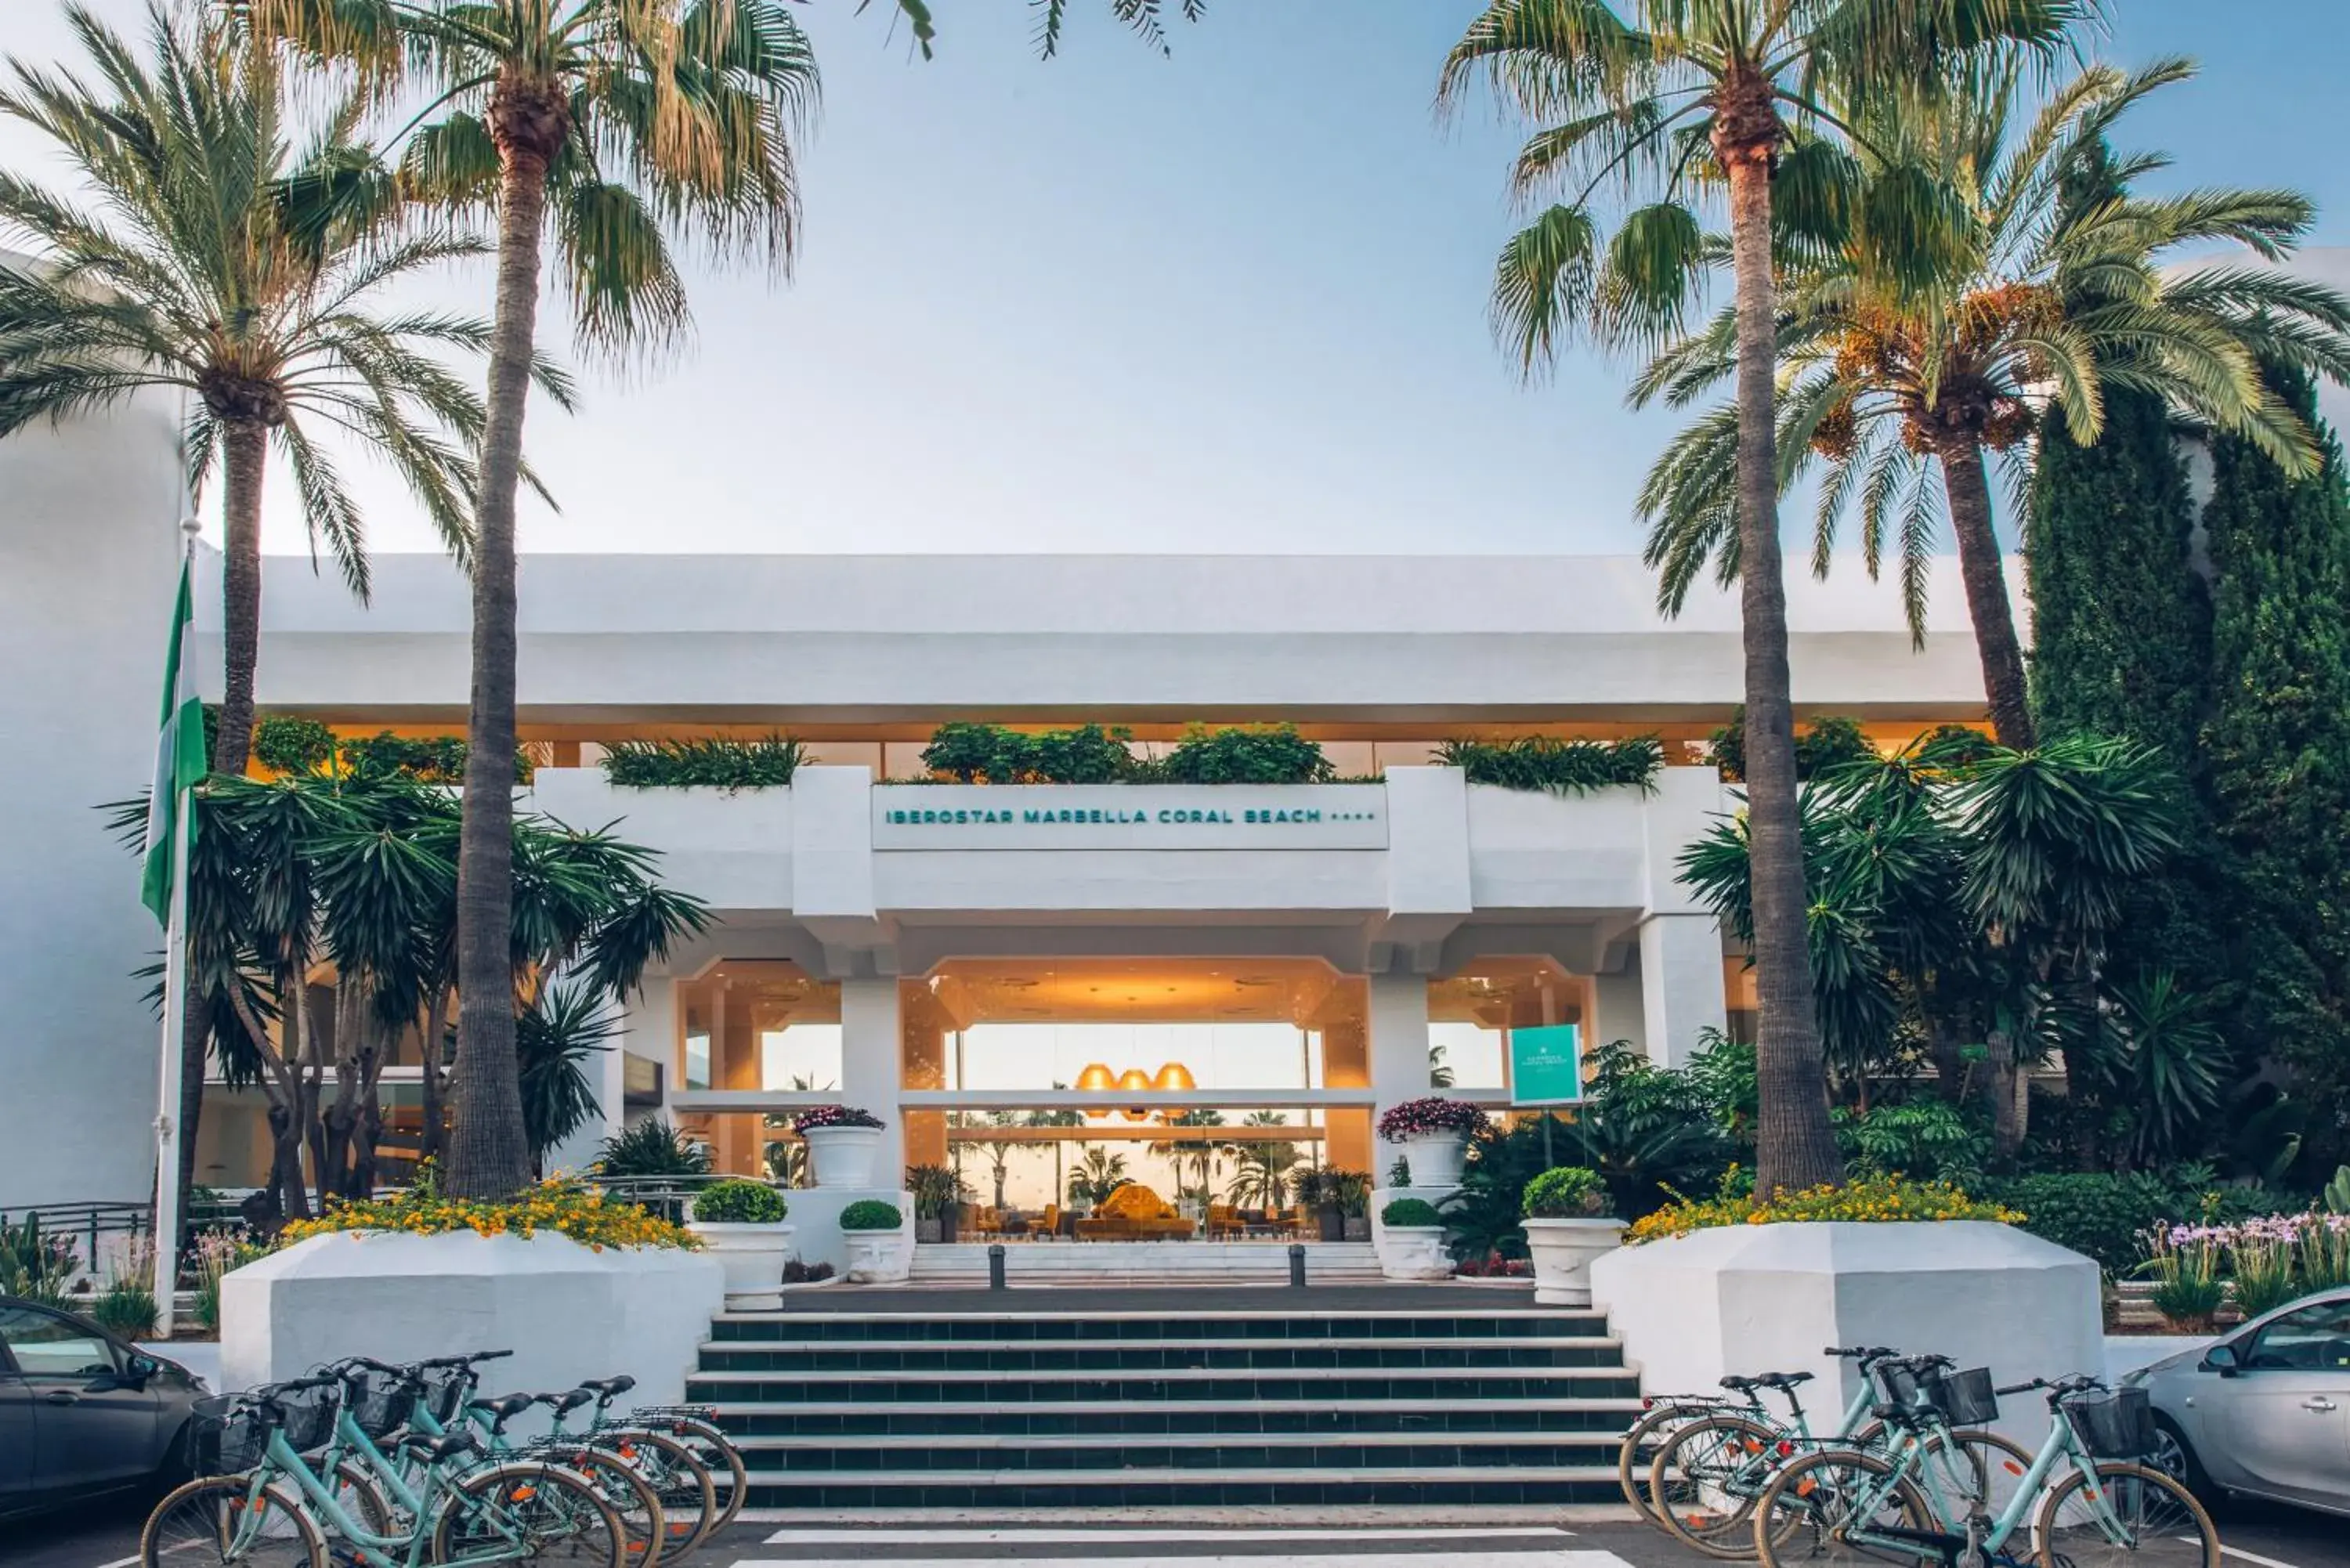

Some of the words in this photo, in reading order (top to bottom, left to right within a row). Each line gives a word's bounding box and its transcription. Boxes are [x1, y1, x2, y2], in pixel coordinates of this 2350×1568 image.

[885, 809, 1014, 824] IBEROSTAR
[1022, 809, 1148, 824] MARBELLA
[1158, 809, 1233, 824] CORAL
[1243, 809, 1322, 823] BEACH
